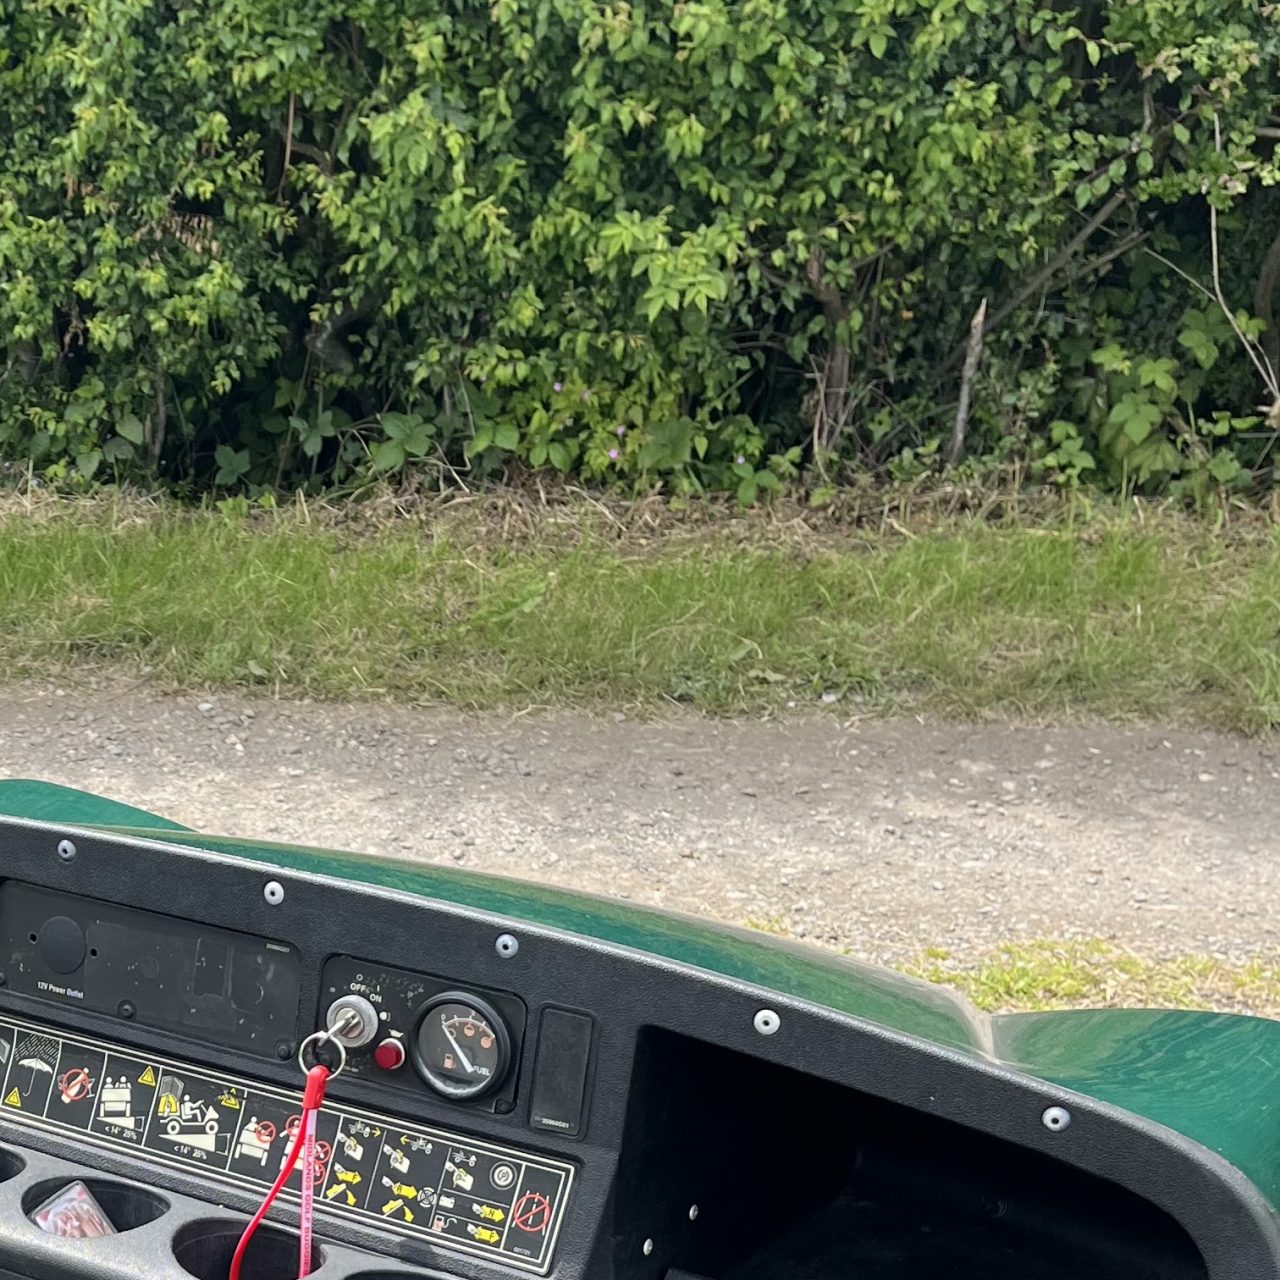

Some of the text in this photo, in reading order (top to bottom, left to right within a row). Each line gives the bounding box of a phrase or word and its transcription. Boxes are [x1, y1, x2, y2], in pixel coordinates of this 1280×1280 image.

[37, 981, 49, 990] 12V
[48, 983, 66, 995] Power
[350, 982, 366, 992] OFF
[369, 993, 382, 1003] ON
[473, 1065, 491, 1076] FUEL
[122, 1128, 137, 1140] 25%
[192, 1148, 207, 1160] 25%
[304, 1134, 314, 1193] MIDLANDS
[304, 1194, 312, 1221] GOLF
